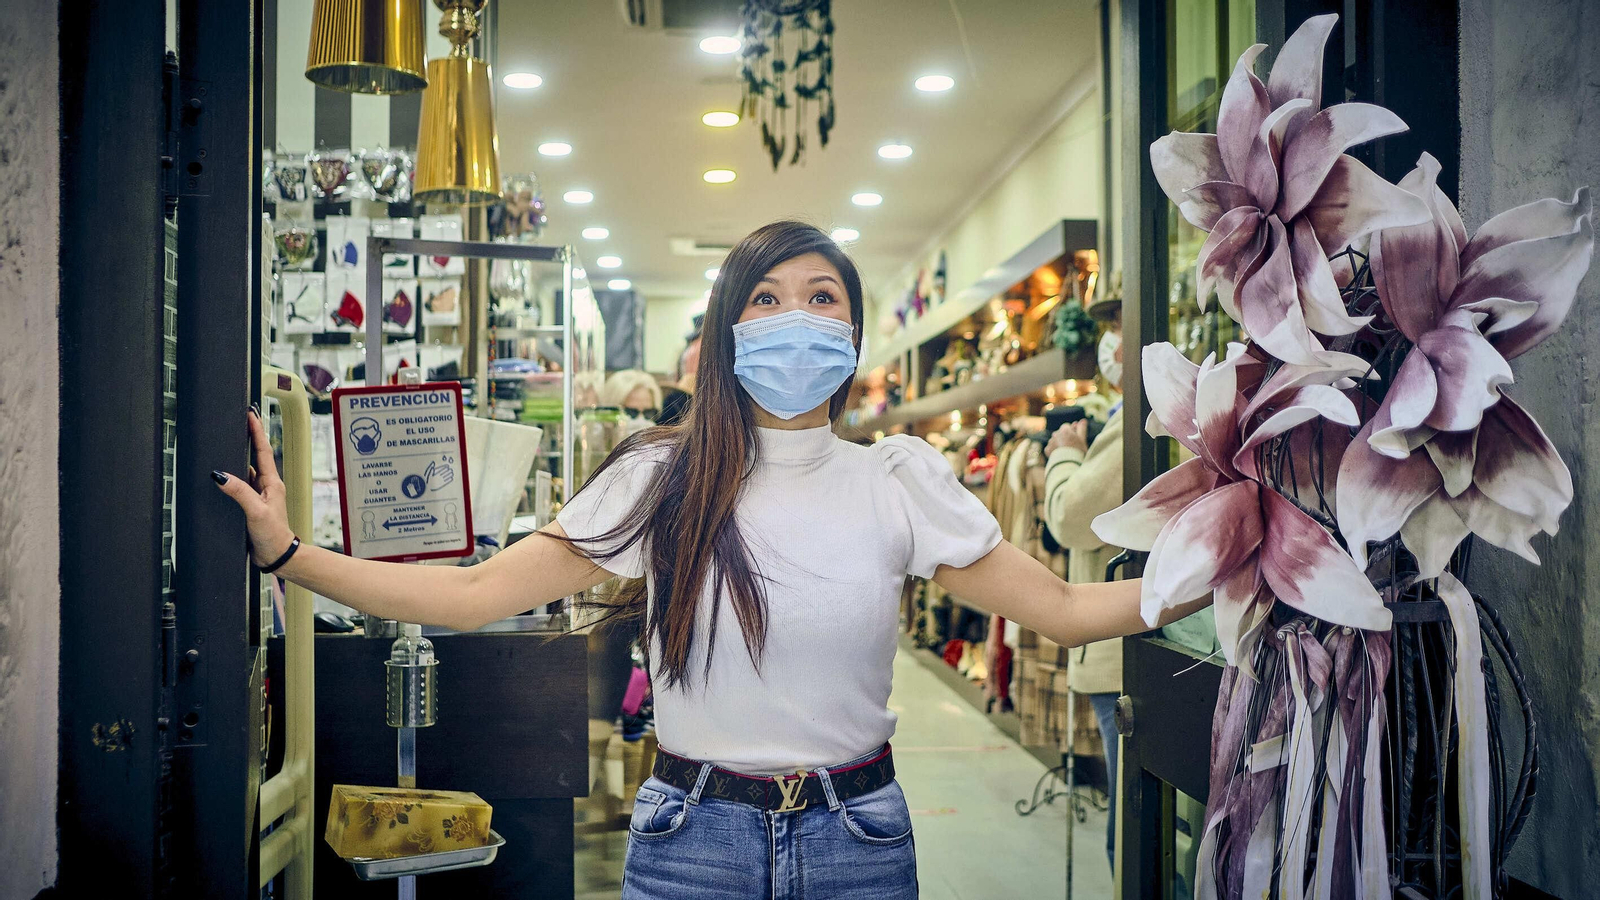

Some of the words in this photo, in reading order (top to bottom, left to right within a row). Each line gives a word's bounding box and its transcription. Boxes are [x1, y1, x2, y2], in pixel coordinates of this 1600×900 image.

[350, 390, 450, 409] PREVENCIÓN
[399, 415, 453, 424] OBLIGATORIO
[418, 426, 435, 434] USO
[400, 436, 455, 446] MASCARILLAS
[362, 461, 393, 469] LAVARSE
[364, 496, 397, 504] GUANTES
[393, 505, 425, 513] MANTENER
[399, 512, 430, 520] DISTANCIA
